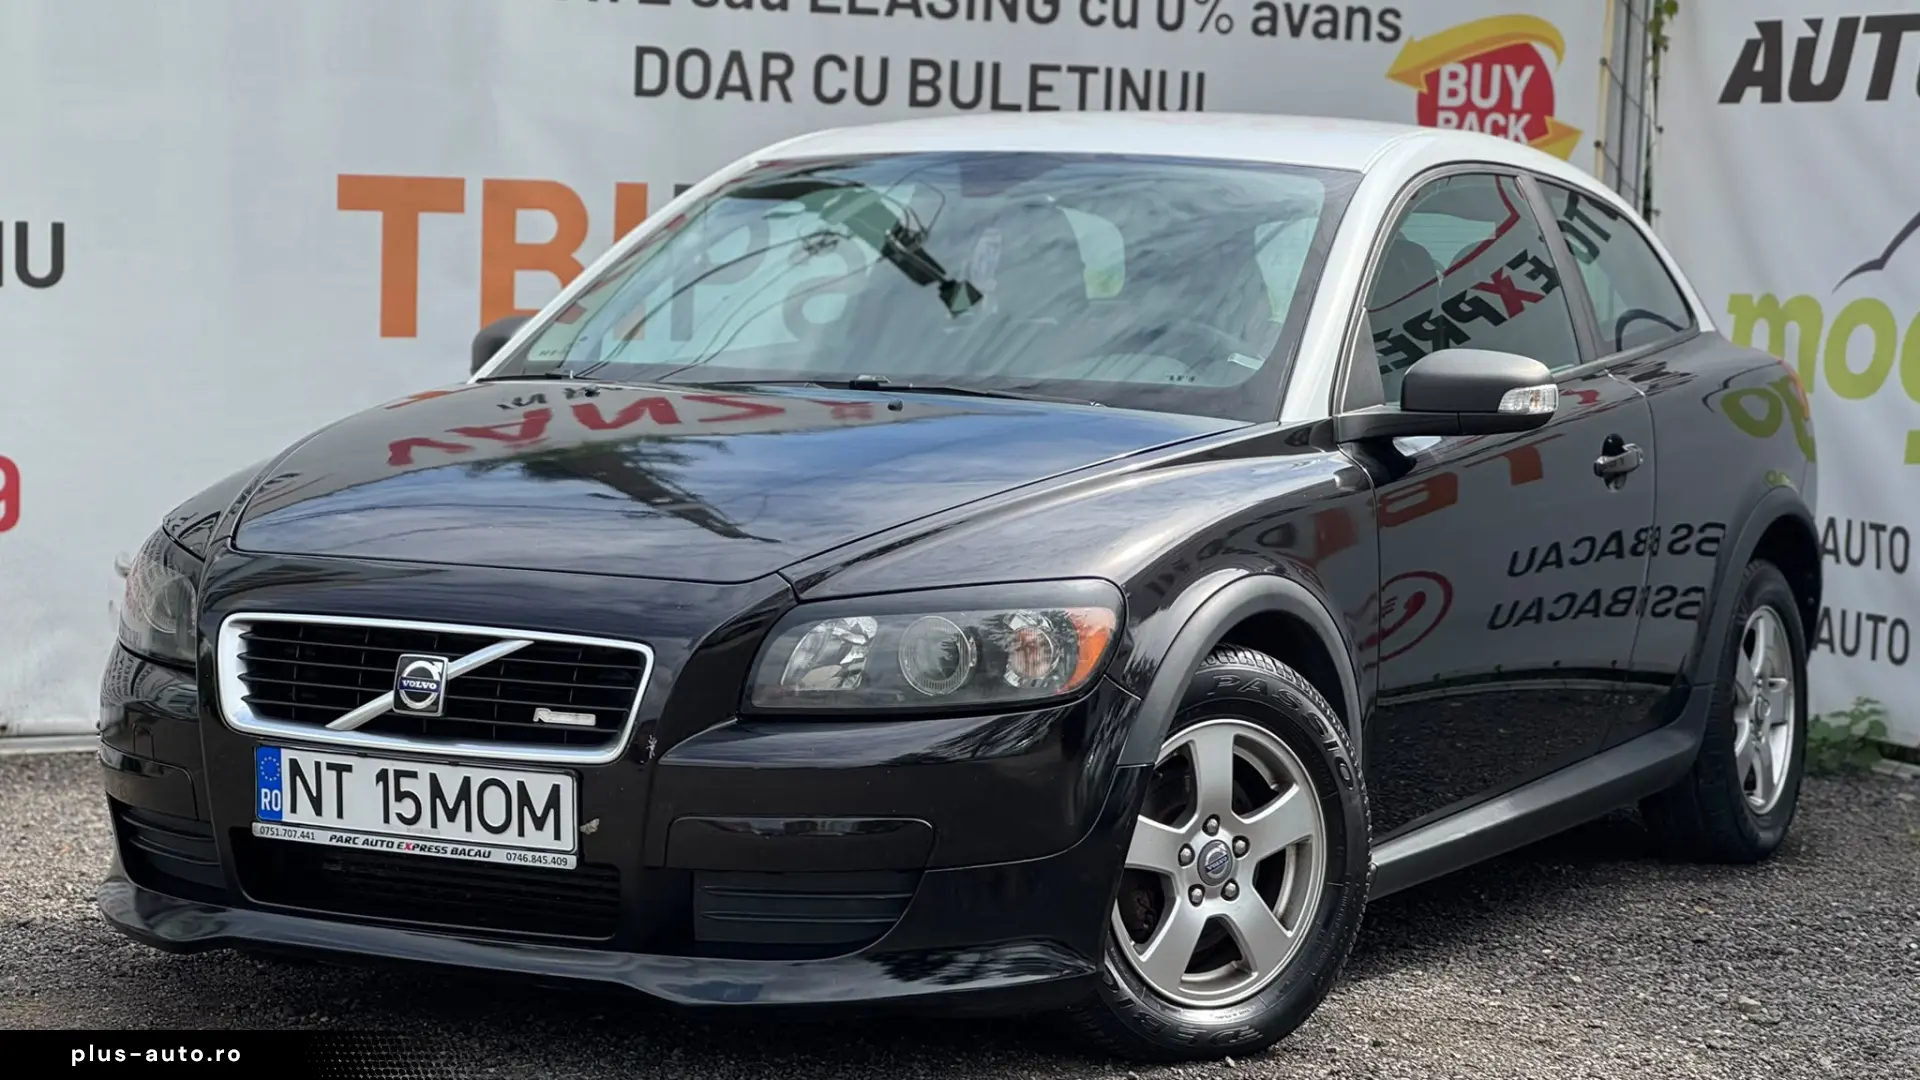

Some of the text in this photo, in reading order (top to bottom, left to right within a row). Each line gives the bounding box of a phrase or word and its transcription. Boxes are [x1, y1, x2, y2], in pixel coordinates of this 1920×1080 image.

[1251, 0, 1403, 43] avans
[634, 45, 1206, 112] DOAR CU BULETINUI
[1717, 13, 1920, 104] AUT
[1437, 62, 1535, 110] BUY
[0, 220, 65, 289] U
[1727, 292, 1920, 406] mo
[1819, 516, 1911, 575] AUTO
[1812, 606, 1911, 667] AUTO
[402, 680, 438, 690] VOLVO
[261, 788, 282, 811] RO
[288, 757, 353, 820] NT
[259, 825, 316, 841] 0751.707.441
[328, 833, 492, 860] PARC AUTO EXPRESS BACAU
[505, 851, 569, 867] 0746.845.409
